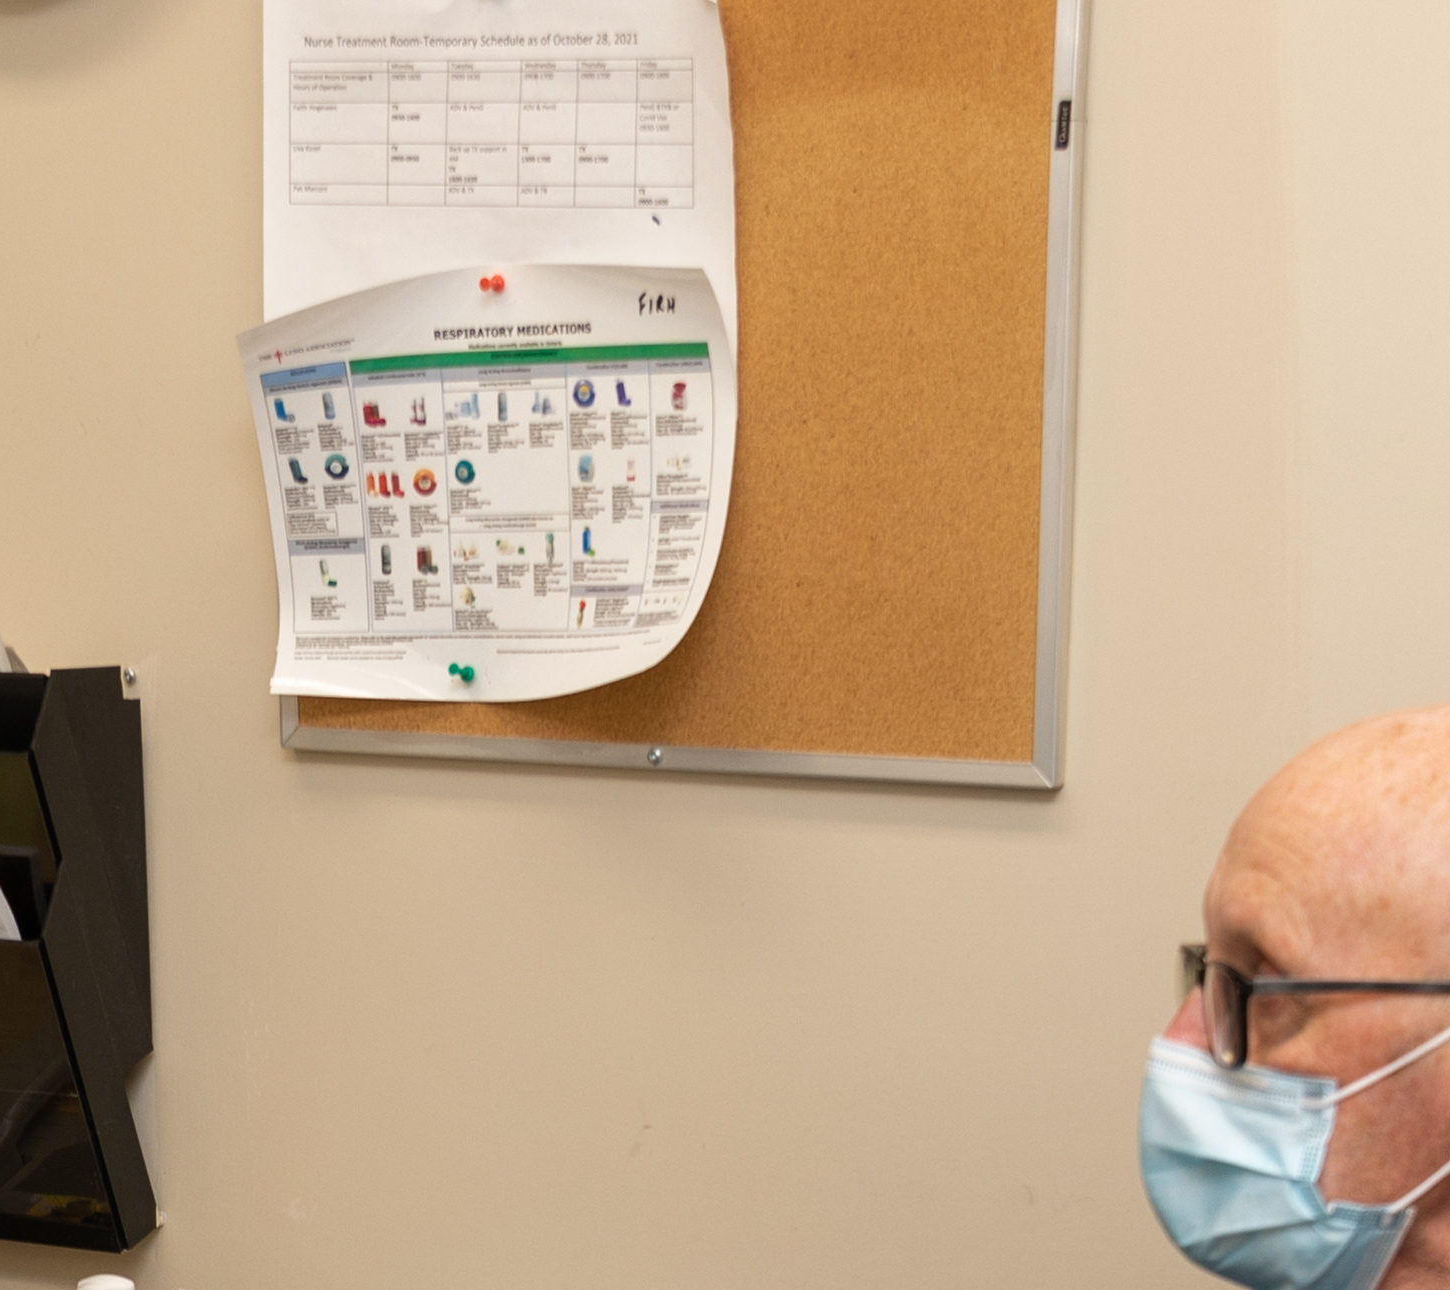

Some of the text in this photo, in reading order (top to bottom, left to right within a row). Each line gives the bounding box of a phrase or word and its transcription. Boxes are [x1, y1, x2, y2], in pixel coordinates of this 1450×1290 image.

[304, 34, 638, 49] Nurse Treatment Room-Temporary Schedule as of October 28, 2021
[434, 323, 591, 341] RESPIRATORY MEDICATIONS
